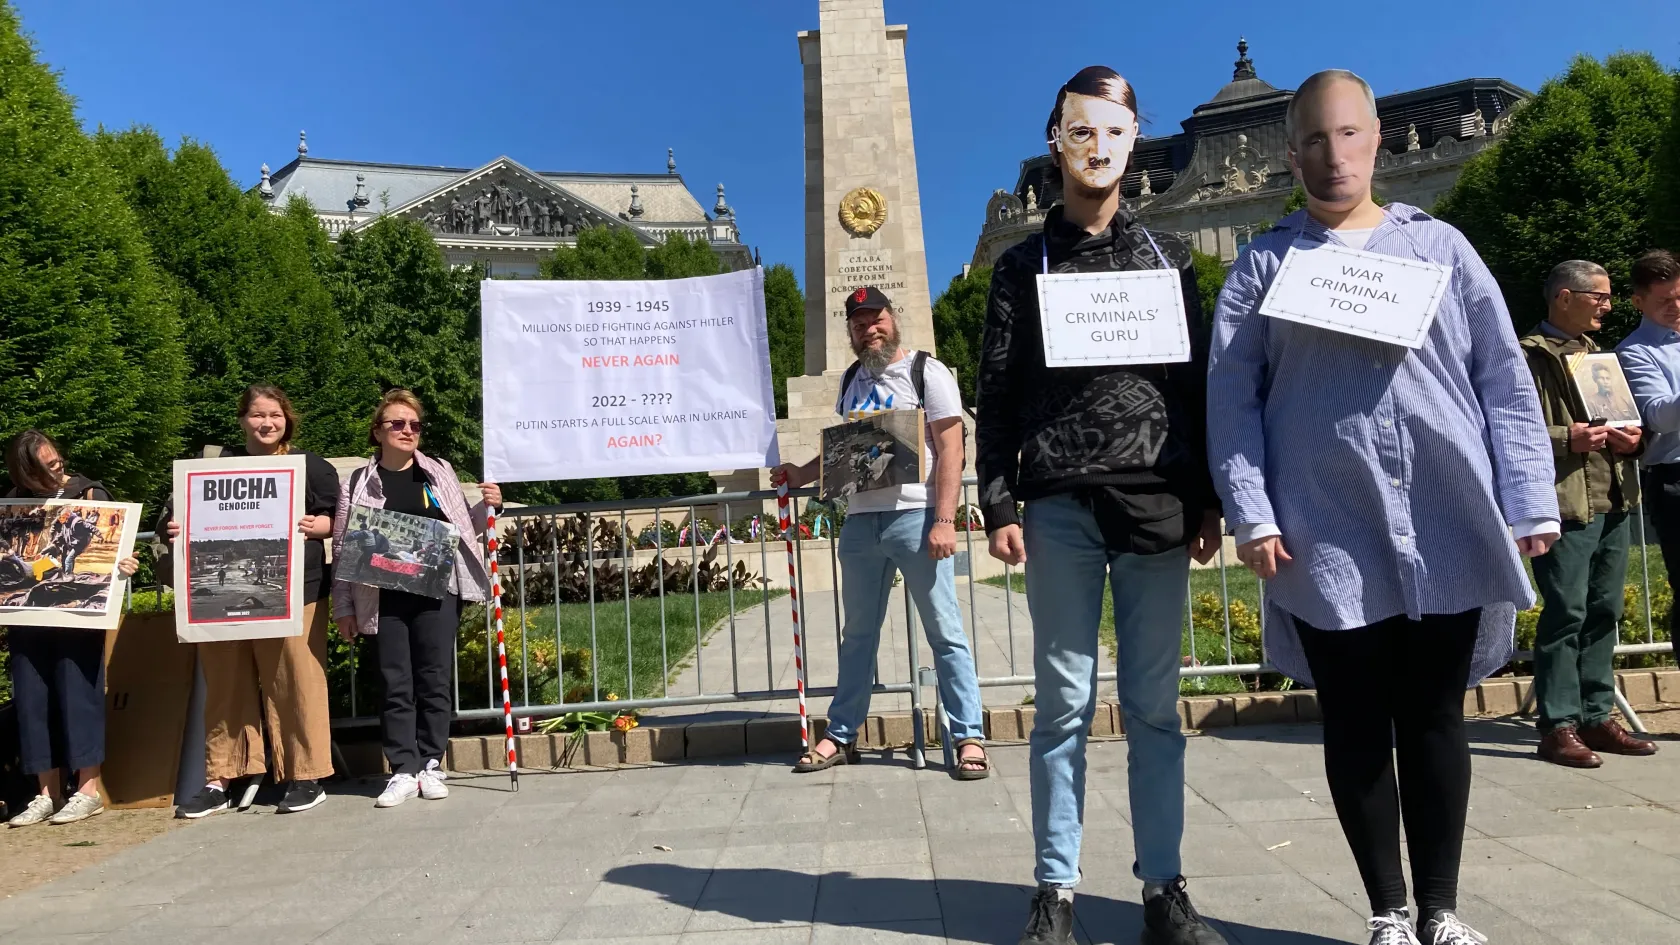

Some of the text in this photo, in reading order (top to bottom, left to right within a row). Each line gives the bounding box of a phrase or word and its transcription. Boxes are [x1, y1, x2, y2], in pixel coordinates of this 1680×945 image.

[838, 264, 892, 273] СОВЕТСКИМ
[1341, 265, 1384, 283] WAR
[847, 274, 886, 282] ГЕРОЯМ
[1091, 292, 1129, 303] WAR
[1310, 276, 1400, 305] CRIMINAL
[588, 302, 621, 312] 1939
[637, 301, 669, 312] 1945
[1328, 296, 1368, 314] TOO
[523, 317, 734, 332] MILLIONS DIED FIGHTING AGAINST HITLER
[584, 336, 676, 346] SO THAT HAPPENS
[1091, 330, 1138, 342] GURU
[582, 354, 680, 368] NEVER AGAIN
[592, 396, 626, 407] 2022
[642, 393, 672, 405] ????
[516, 421, 547, 429] PUTIN
[552, 419, 588, 428] STARTS
[602, 418, 625, 426] FULL
[629, 416, 658, 425] SCALE
[662, 415, 686, 423] WAR
[690, 414, 699, 422] IN
[703, 410, 747, 421] UKRAINE
[607, 434, 662, 448] AGAIN?
[203, 478, 277, 501] BUCHA
[218, 501, 260, 511] GENOCIDE
